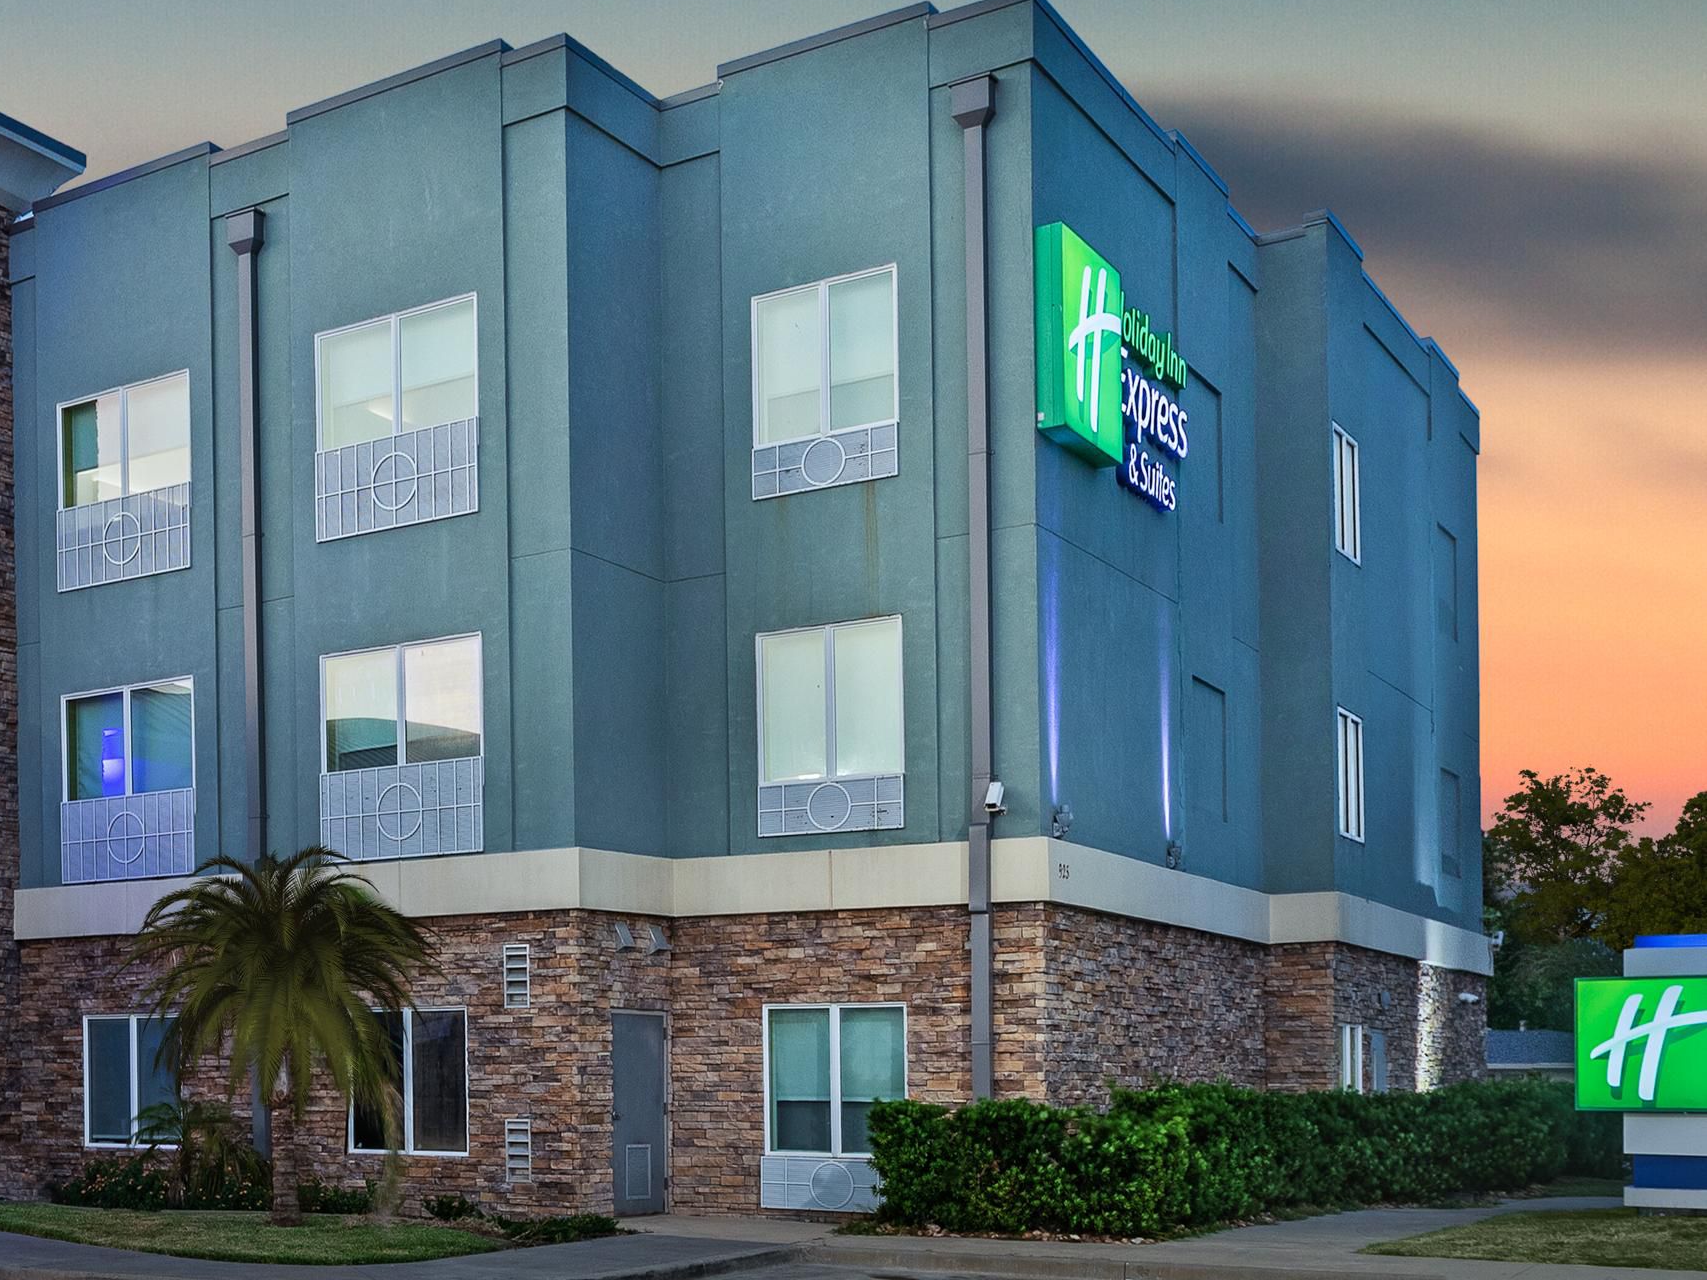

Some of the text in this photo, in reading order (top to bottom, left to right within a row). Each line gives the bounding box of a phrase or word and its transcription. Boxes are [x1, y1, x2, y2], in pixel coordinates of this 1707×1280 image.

[1167, 332, 1187, 389] Inn
[1129, 443, 1176, 511] & Suites
